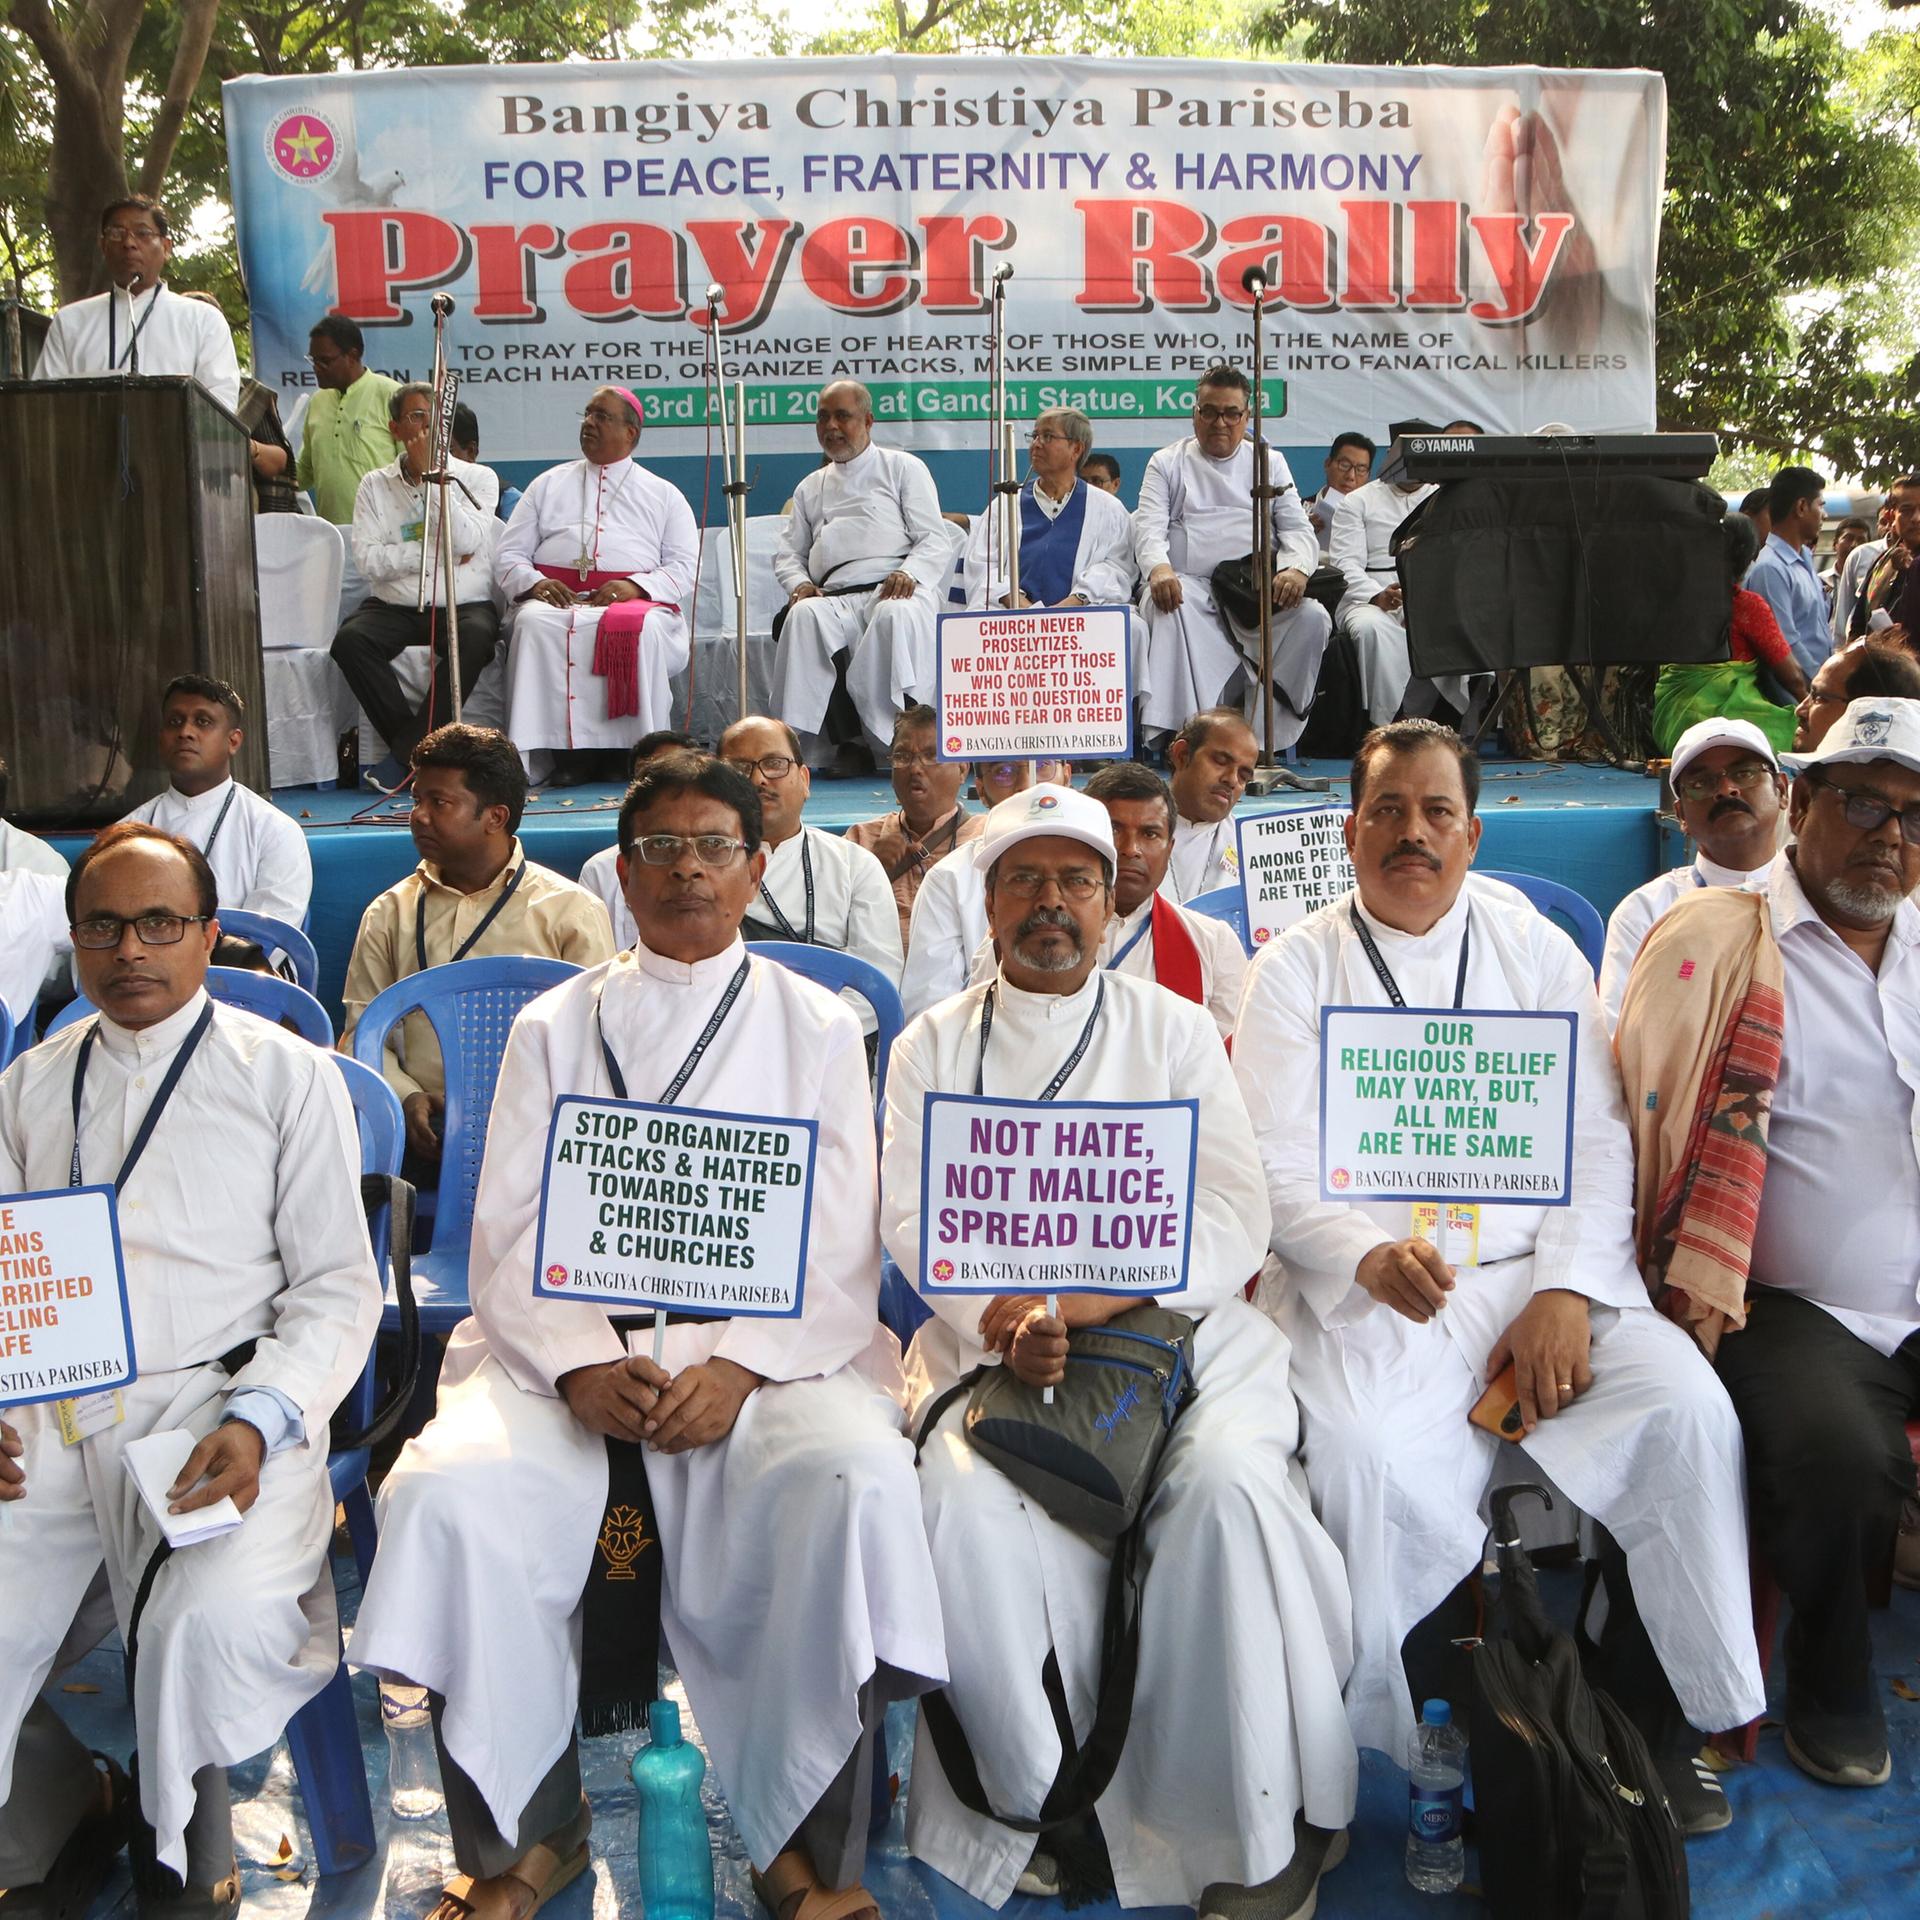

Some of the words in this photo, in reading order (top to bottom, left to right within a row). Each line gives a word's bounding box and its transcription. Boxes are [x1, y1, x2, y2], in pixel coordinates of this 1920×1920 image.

[500, 92, 770, 143] Bangiya
[795, 87, 1106, 138] Christiya
[1132, 87, 1413, 130] Pariseba
[485, 159, 585, 199] FOR
[605, 155, 786, 201] PEACE,
[804, 152, 1111, 192] FRATERNITY
[1126, 152, 1160, 191] &
[1175, 153, 1423, 191] HARMONY
[322, 208, 1013, 333] Prayer
[1073, 198, 1575, 328] Rally
[458, 345, 494, 360] TO
[504, 343, 576, 360] PRAY
[585, 342, 641, 358] FOR
[650, 340, 704, 357] THE
[718, 337, 832, 354] CHANGE
[841, 336, 877, 353] OF
[887, 334, 998, 351] HEARTS
[1007, 333, 1043, 350] OF
[1053, 333, 1144, 349] THOSE
[1154, 333, 1226, 351] WHO,
[1270, 333, 1322, 348] THE
[1332, 333, 1409, 349] NAME
[1418, 333, 1453, 348] OF
[552, 363, 670, 382] HATRED,
[679, 360, 823, 379] ORGANIZE
[831, 357, 964, 376] ATTACKS,
[974, 356, 1052, 372] MAKE
[1062, 355, 1162, 372] SIMPLE
[1172, 354, 1278, 371] PEOPLE
[1288, 354, 1351, 370] INTO
[1360, 354, 1507, 370] FANATICAL
[1516, 353, 1627, 370] KILLERS
[644, 394, 694, 418] 3rd
[879, 390, 907, 413] at
[1038, 386, 1145, 415] Statue,
[1426, 438, 1475, 453] YAMAHA
[979, 618, 1036, 636] CHURCH
[1040, 617, 1085, 633] NEVER
[982, 635, 1083, 654] PROSELYTIZES.
[951, 658, 972, 673] WE
[976, 656, 1010, 672] ONLY
[1014, 654, 1066, 671] ACCEPT
[1071, 652, 1116, 669] THOSE
[971, 674, 1003, 690] WHO
[1007, 672, 1046, 689] COME
[1051, 672, 1068, 687] TO
[1074, 671, 1096, 686] US.
[945, 693, 987, 709] THERE
[992, 692, 1005, 707] IS
[1010, 691, 1028, 706] NO
[1032, 689, 1101, 708] QUESTION
[1106, 688, 1124, 704] OF
[946, 710, 1010, 727] SHOWING
[1015, 709, 1048, 725] FEAR
[1053, 708, 1072, 724] OR
[1077, 707, 1123, 723] GREED
[966, 736, 1013, 751] BANGIYA
[1014, 735, 1070, 750] CHRISTIYA
[1071, 734, 1123, 748] PARISEBA
[1256, 817, 1305, 836] THOSE
[1310, 814, 1345, 829] WHO
[1249, 850, 1305, 869] AMONG
[1310, 848, 1348, 863] PEOP
[1263, 866, 1306, 884] NAME
[1312, 864, 1331, 879] OF
[1258, 885, 1288, 902] ARE
[1293, 882, 1322, 898] THE
[1423, 1021, 1474, 1046] OUR
[1340, 1048, 1466, 1074] RELIGIOUS
[1475, 1052, 1557, 1076] BELIEF
[1355, 1076, 1406, 1099] MAY
[1414, 1077, 1479, 1105] VARY,
[1488, 1079, 1539, 1107] BUT,
[1393, 1104, 1436, 1128] ALL
[1444, 1106, 1498, 1130] MEN
[575, 1110, 639, 1140] STOP
[646, 1119, 791, 1157] ORGANIZED
[970, 1117, 1041, 1157] NOT
[1054, 1121, 1155, 1163] HATE,
[1357, 1131, 1403, 1155] ARE
[1412, 1133, 1457, 1156] THE
[1465, 1134, 1533, 1159] SAME
[557, 1139, 667, 1174] ATTACKS
[674, 1152, 693, 1178] &
[702, 1155, 802, 1187] HATRED
[587, 1171, 710, 1208] TOWARDS
[718, 1186, 767, 1213] THE
[945, 1163, 1016, 1201] NOT
[1029, 1167, 1175, 1209] MALICE,
[1355, 1170, 1414, 1188] BANGIYA
[1416, 1171, 1491, 1190] CHRISTIYA
[1493, 1173, 1560, 1192] PARISEBA
[599, 1202, 751, 1241] CHRISTIANS
[938, 1208, 1078, 1248] SPREAD
[1092, 1212, 1179, 1249] LOVE
[589, 1230, 607, 1255] &
[617, 1233, 756, 1270] CHURCHES
[573, 1269, 638, 1291] BANGIYA
[641, 1275, 717, 1301] CHRISTIYA
[720, 1284, 790, 1304] PARISEBA
[960, 1262, 1024, 1281] BANGIYA
[1028, 1263, 1106, 1281] CHRISTIYA
[1109, 1264, 1177, 1283] PARISEBA
[0, 1275, 94, 1307] RRIFIED
[0, 1370, 47, 1394] STIYA
[49, 1358, 123, 1386] PARISEBA
